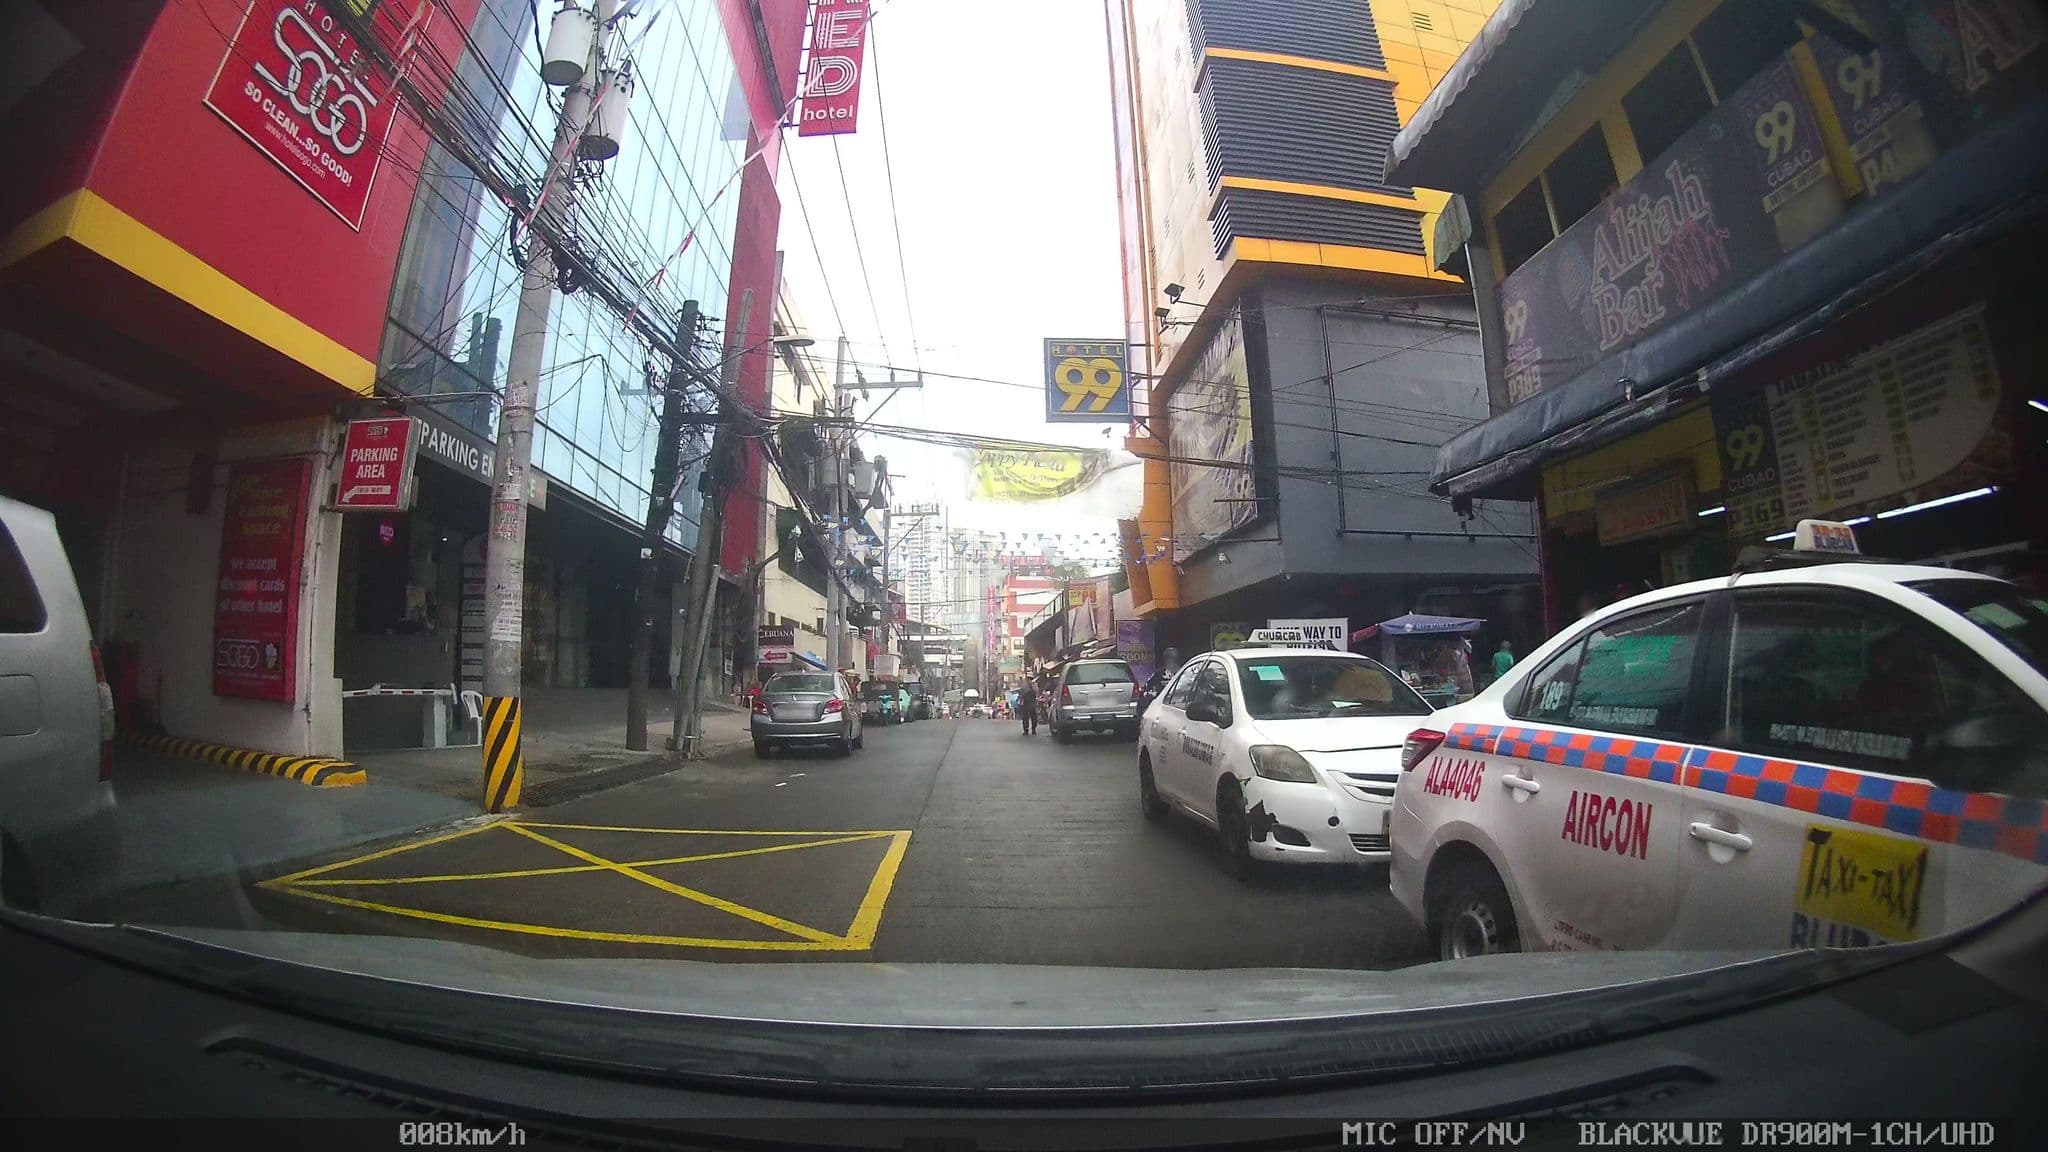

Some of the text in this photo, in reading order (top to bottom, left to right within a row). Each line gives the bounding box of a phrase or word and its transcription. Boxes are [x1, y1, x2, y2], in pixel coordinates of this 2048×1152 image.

[808, 0, 863, 98] ED
[253, 7, 378, 154] SOGO
[244, 80, 262, 103] SO
[321, 152, 353, 187] GOOD!
[803, 105, 853, 121] hotel
[1755, 101, 1796, 166] 99
[1767, 148, 1812, 187] CUBAO
[1590, 159, 1713, 292] Alijah
[1502, 299, 1528, 346] 99
[1591, 270, 1667, 352] Bar
[1052, 344, 1123, 356] HOTEL
[1054, 357, 1124, 412] 99
[350, 447, 398, 462] PARKING
[420, 421, 480, 471] PARKING
[1726, 424, 1764, 470] 99
[355, 464, 386, 478] AREA
[1728, 466, 1776, 492] CUBAO
[758, 629, 794, 639] CEBUANA
[1303, 626, 1342, 639] WAY TO
[1540, 681, 1564, 710] 189
[1424, 756, 1486, 803] ALA4046
[1561, 790, 1654, 861] AIRCON
